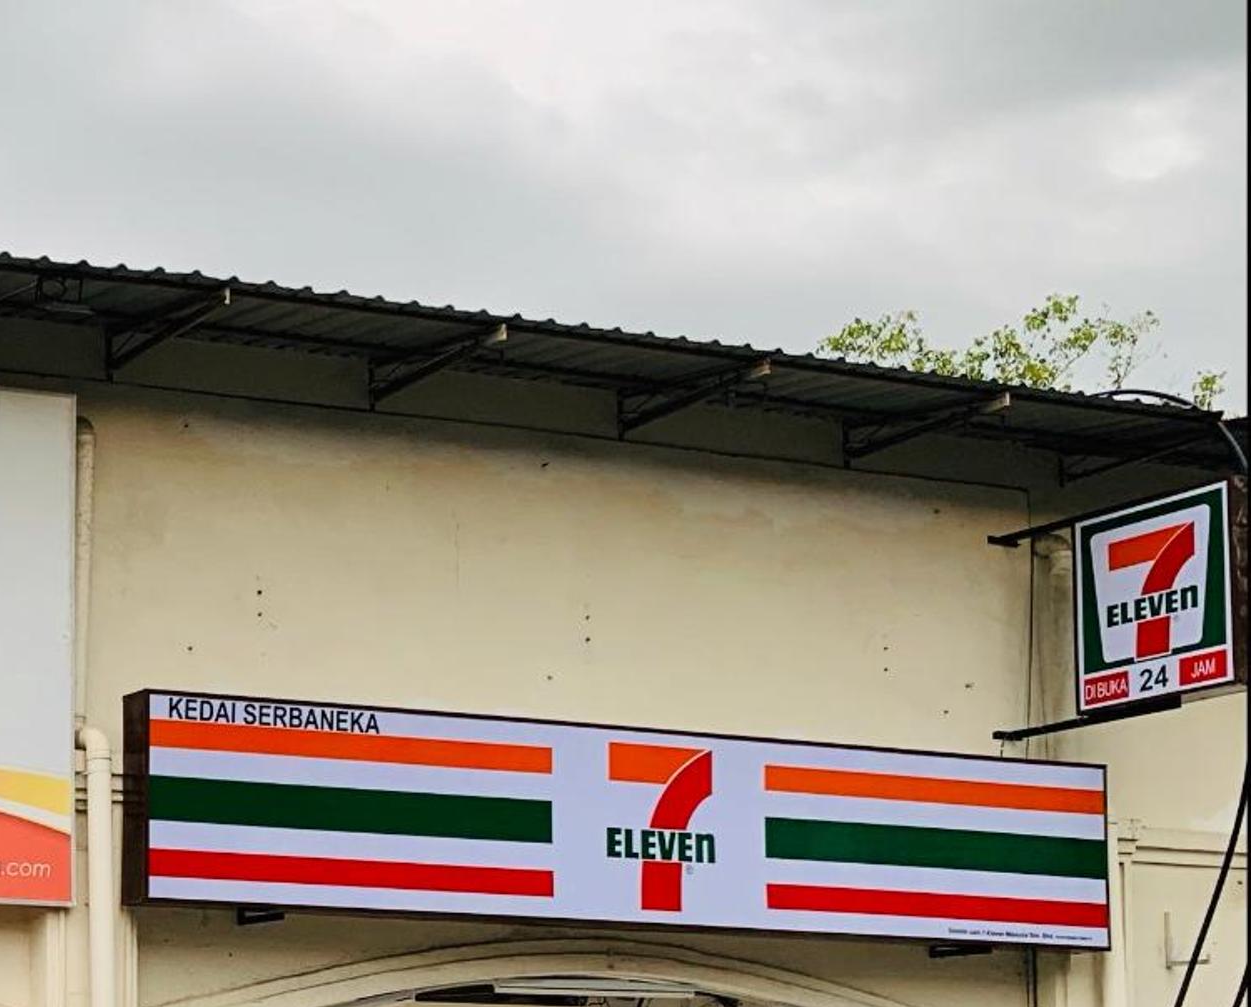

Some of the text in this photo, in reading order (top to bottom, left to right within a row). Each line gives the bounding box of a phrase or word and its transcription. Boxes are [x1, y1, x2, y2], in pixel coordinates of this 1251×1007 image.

[1109, 521, 1194, 659] 7
[169, 698, 379, 735] KEDAI SERBANEKA
[1139, 665, 1168, 692] 24
[1191, 659, 1216, 679] JAM
[609, 743, 711, 911] 7
